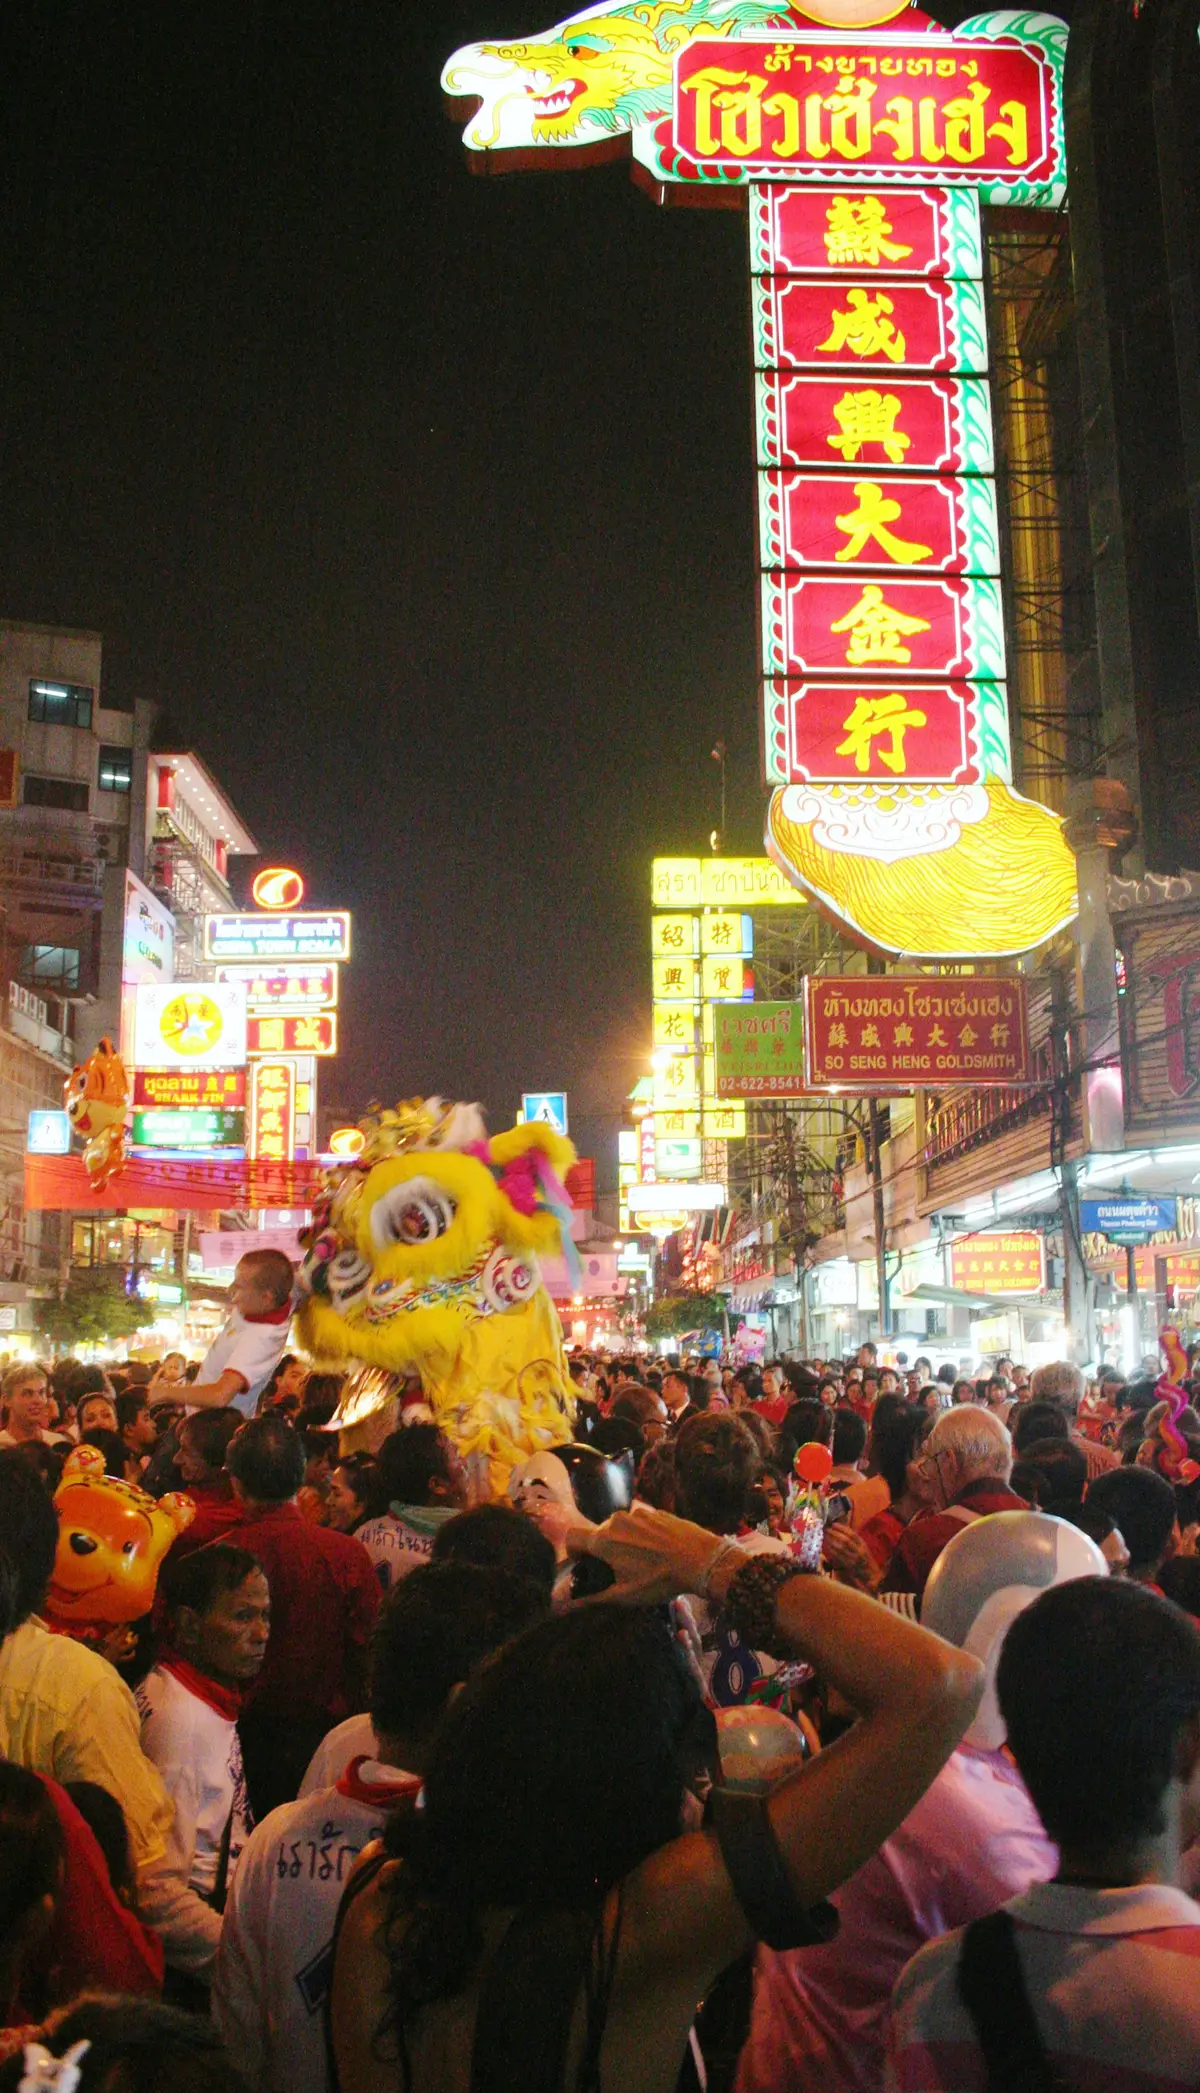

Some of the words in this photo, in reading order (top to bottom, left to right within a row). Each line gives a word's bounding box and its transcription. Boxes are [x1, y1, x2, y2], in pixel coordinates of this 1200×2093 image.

[764, 44, 978, 78] ห้างขายทอง
[825, 1055, 844, 1069] SO
[849, 1055, 887, 1069] SENG
[892, 1055, 931, 1069] HENG
[936, 1054, 1016, 1069] GOLDSMITH
[144, 1077, 199, 1095] หูฉลาม
